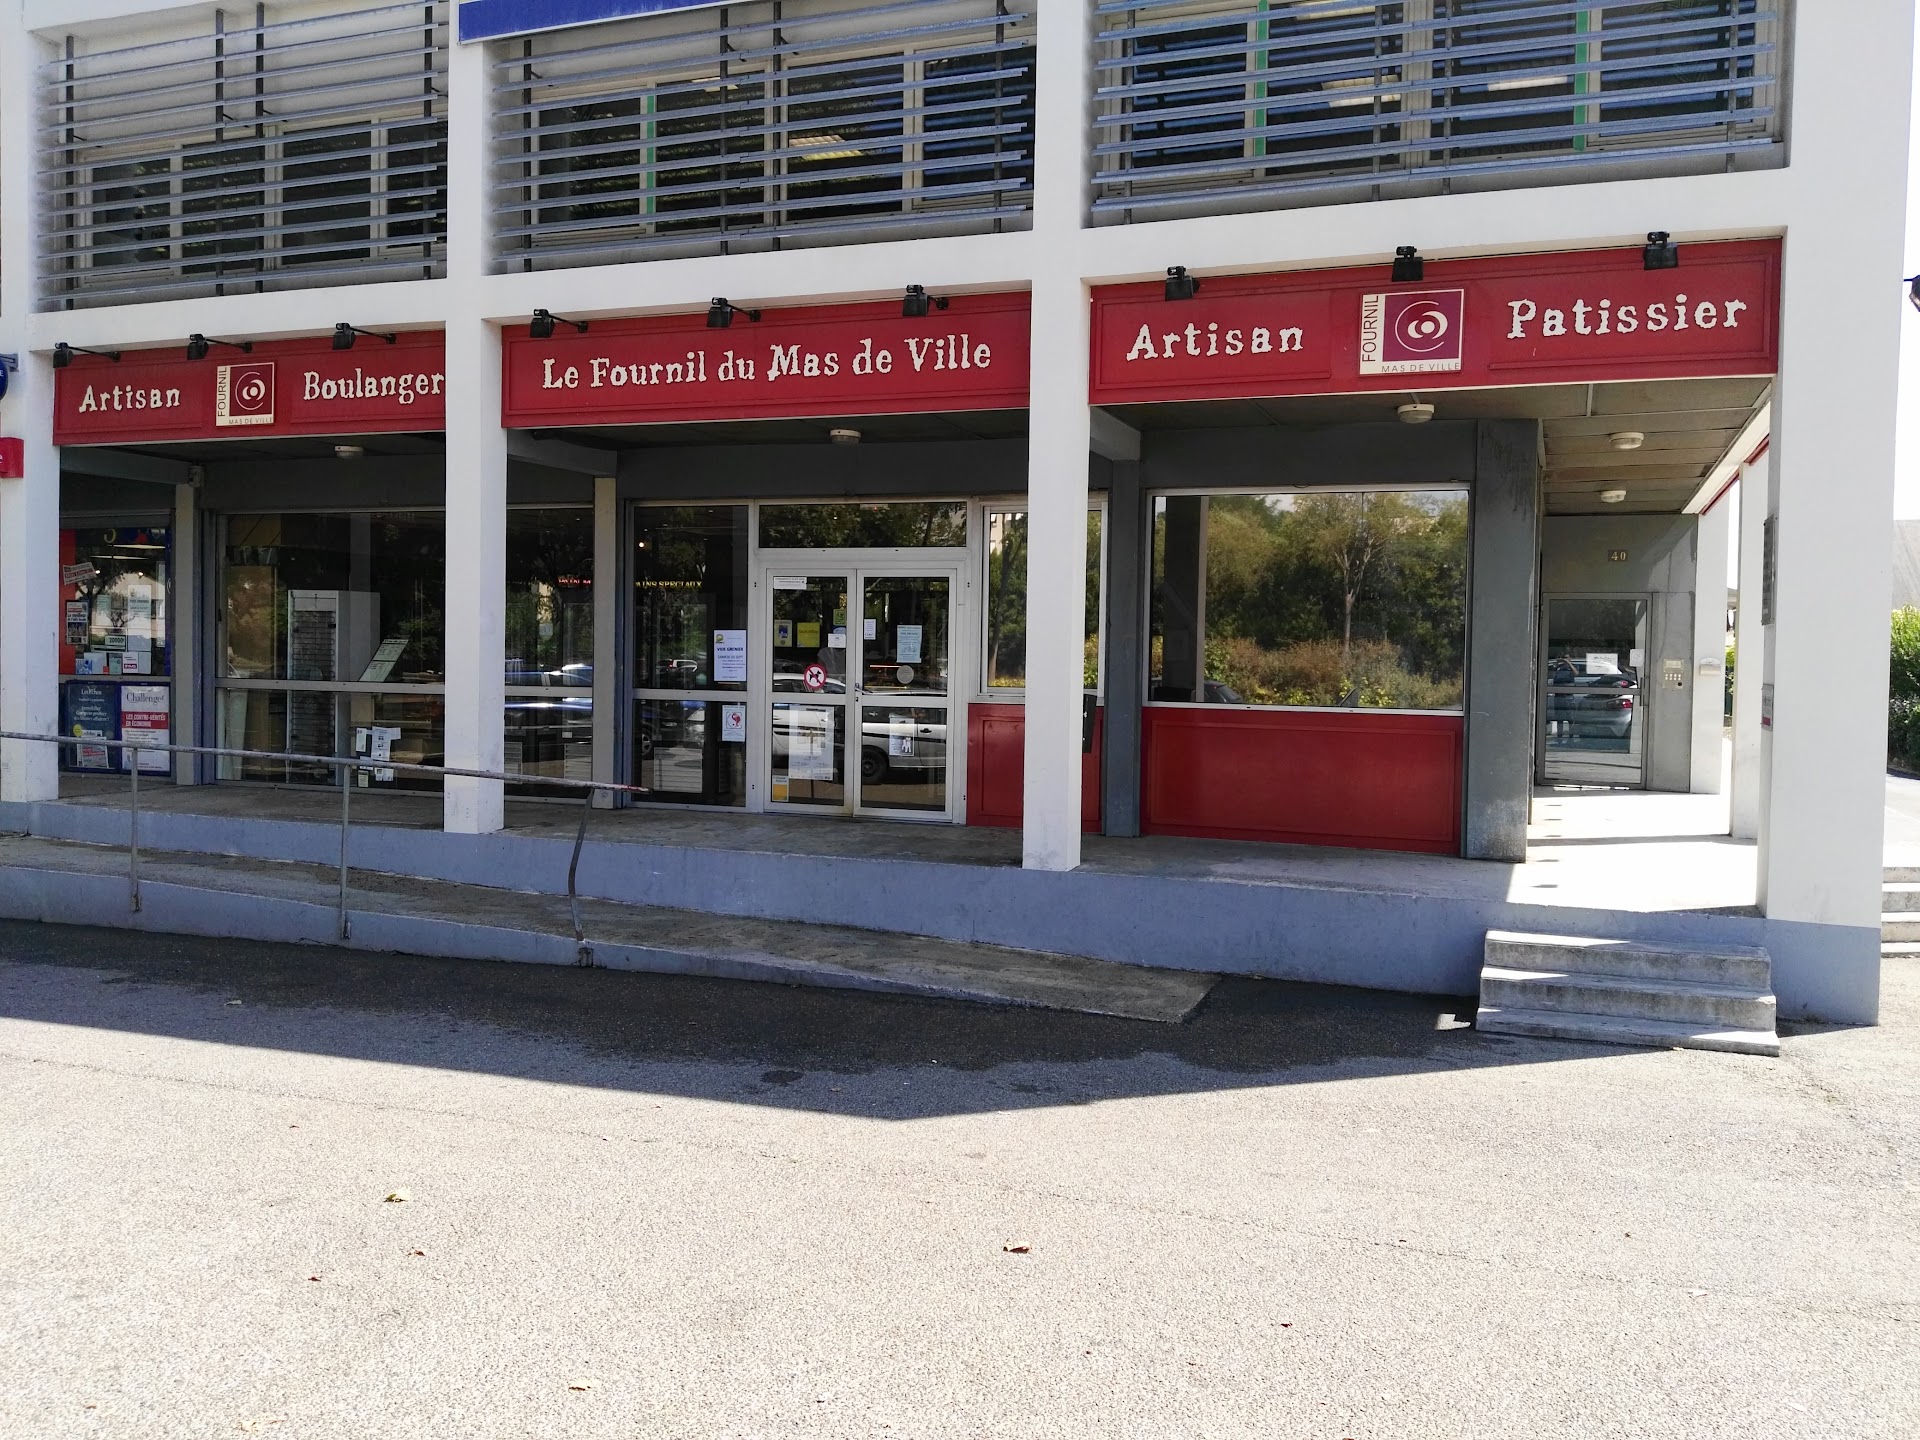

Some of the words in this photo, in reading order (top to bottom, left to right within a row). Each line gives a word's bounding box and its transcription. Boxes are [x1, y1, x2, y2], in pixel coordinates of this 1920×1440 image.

[1361, 294, 1379, 363] FOURNIL
[1506, 293, 1747, 339] Patissier
[542, 358, 579, 389] Le
[589, 350, 707, 388] Fournil
[717, 350, 756, 382] du
[766, 344, 840, 382] Mas
[852, 337, 892, 375] de
[903, 333, 991, 372] Ville
[1126, 322, 1304, 362] Artisan
[303, 367, 445, 405] Boulanger
[1381, 365, 1406, 374] MAS
[1409, 364, 1425, 373] DE
[1428, 362, 1460, 371] VILLE
[78, 385, 180, 413] Artisan
[218, 366, 227, 417] FOURNIL
[255, 416, 273, 424] VILLE
[1611, 551, 1626, 561] 40
